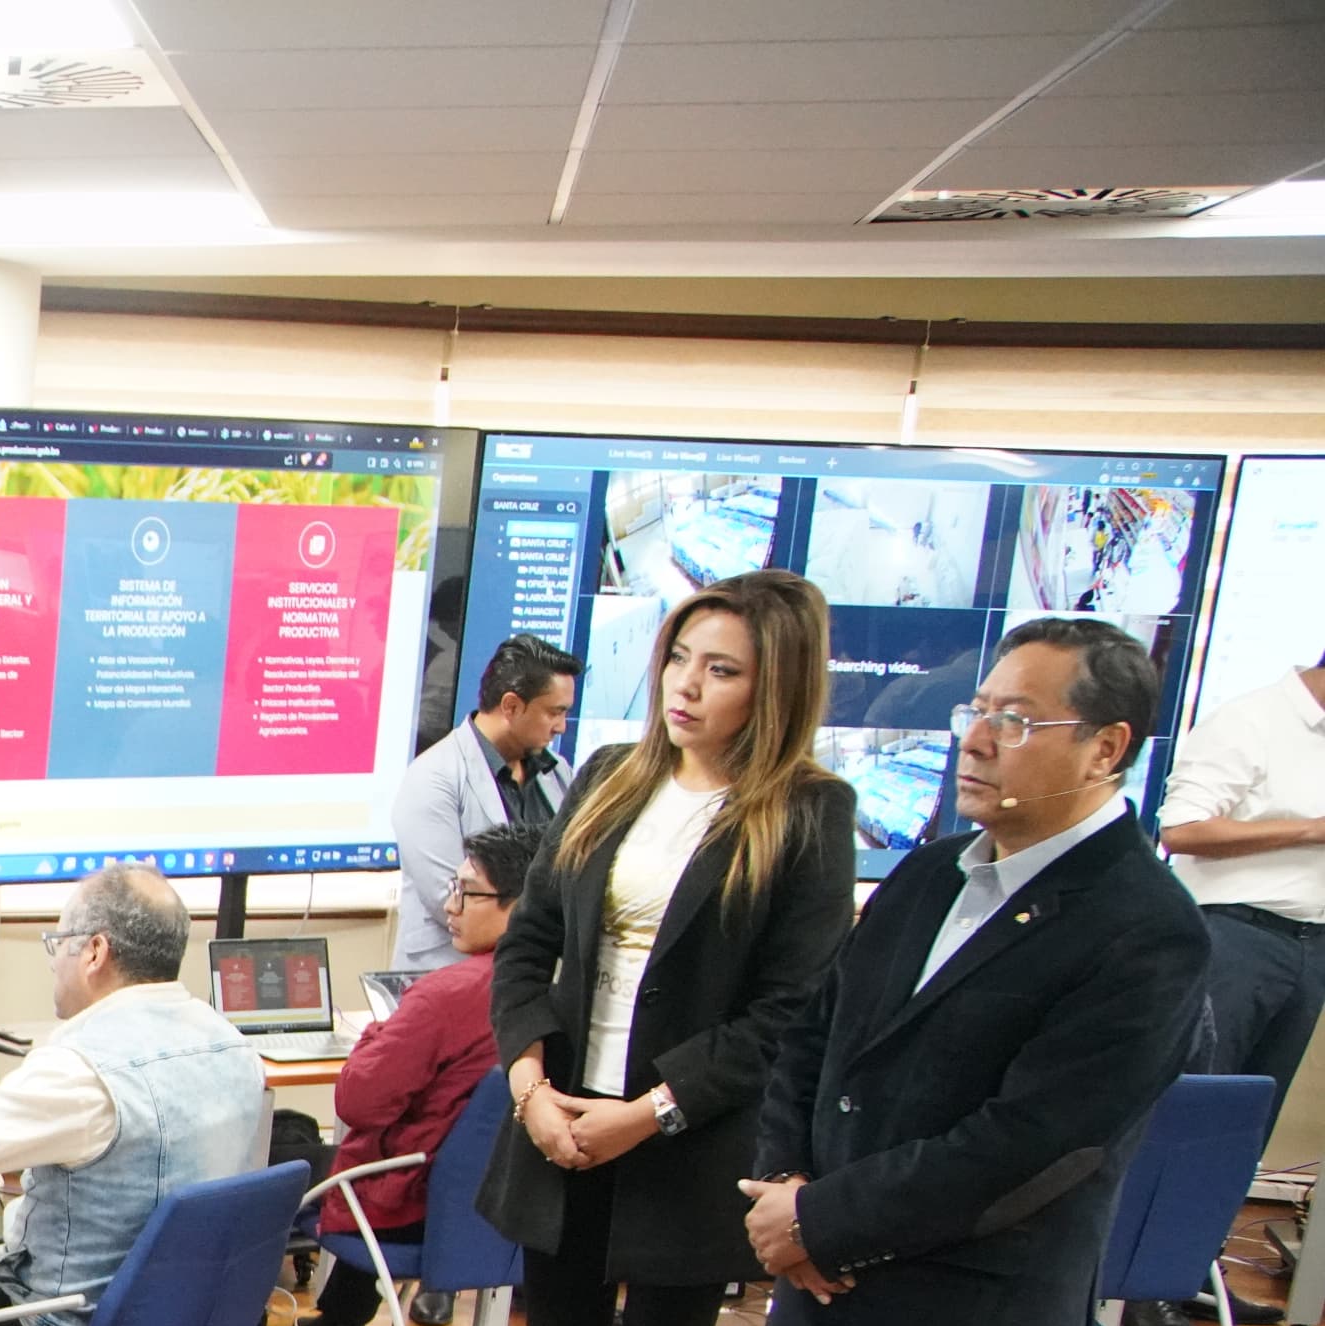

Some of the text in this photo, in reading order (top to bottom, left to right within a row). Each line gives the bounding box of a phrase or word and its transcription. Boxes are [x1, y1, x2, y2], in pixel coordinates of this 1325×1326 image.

[494, 501, 539, 511] SANTA CRUZ
[521, 538, 546, 548] SANTA
[546, 539, 567, 549] CRUZ
[520, 552, 544, 561] SANTA
[545, 552, 565, 562] CRUZ
[529, 566, 558, 575] PUERTA
[119, 579, 177, 592] SISTEMA DE
[289, 582, 338, 594] SERVICIOS
[25, 593, 33, 606] Y
[111, 594, 183, 607] INFORMACIÓN
[268, 597, 357, 608] INSTITUCIONALES Y
[85, 609, 206, 622] TERRITORIAL DE APOYO A
[524, 607, 560, 616] ALMACEN
[282, 612, 339, 624] NORMATIVA
[103, 623, 187, 637] LA PRODUCCIÓN
[279, 626, 340, 638] PRODUCTIVA
[827, 659, 886, 676] Searching
